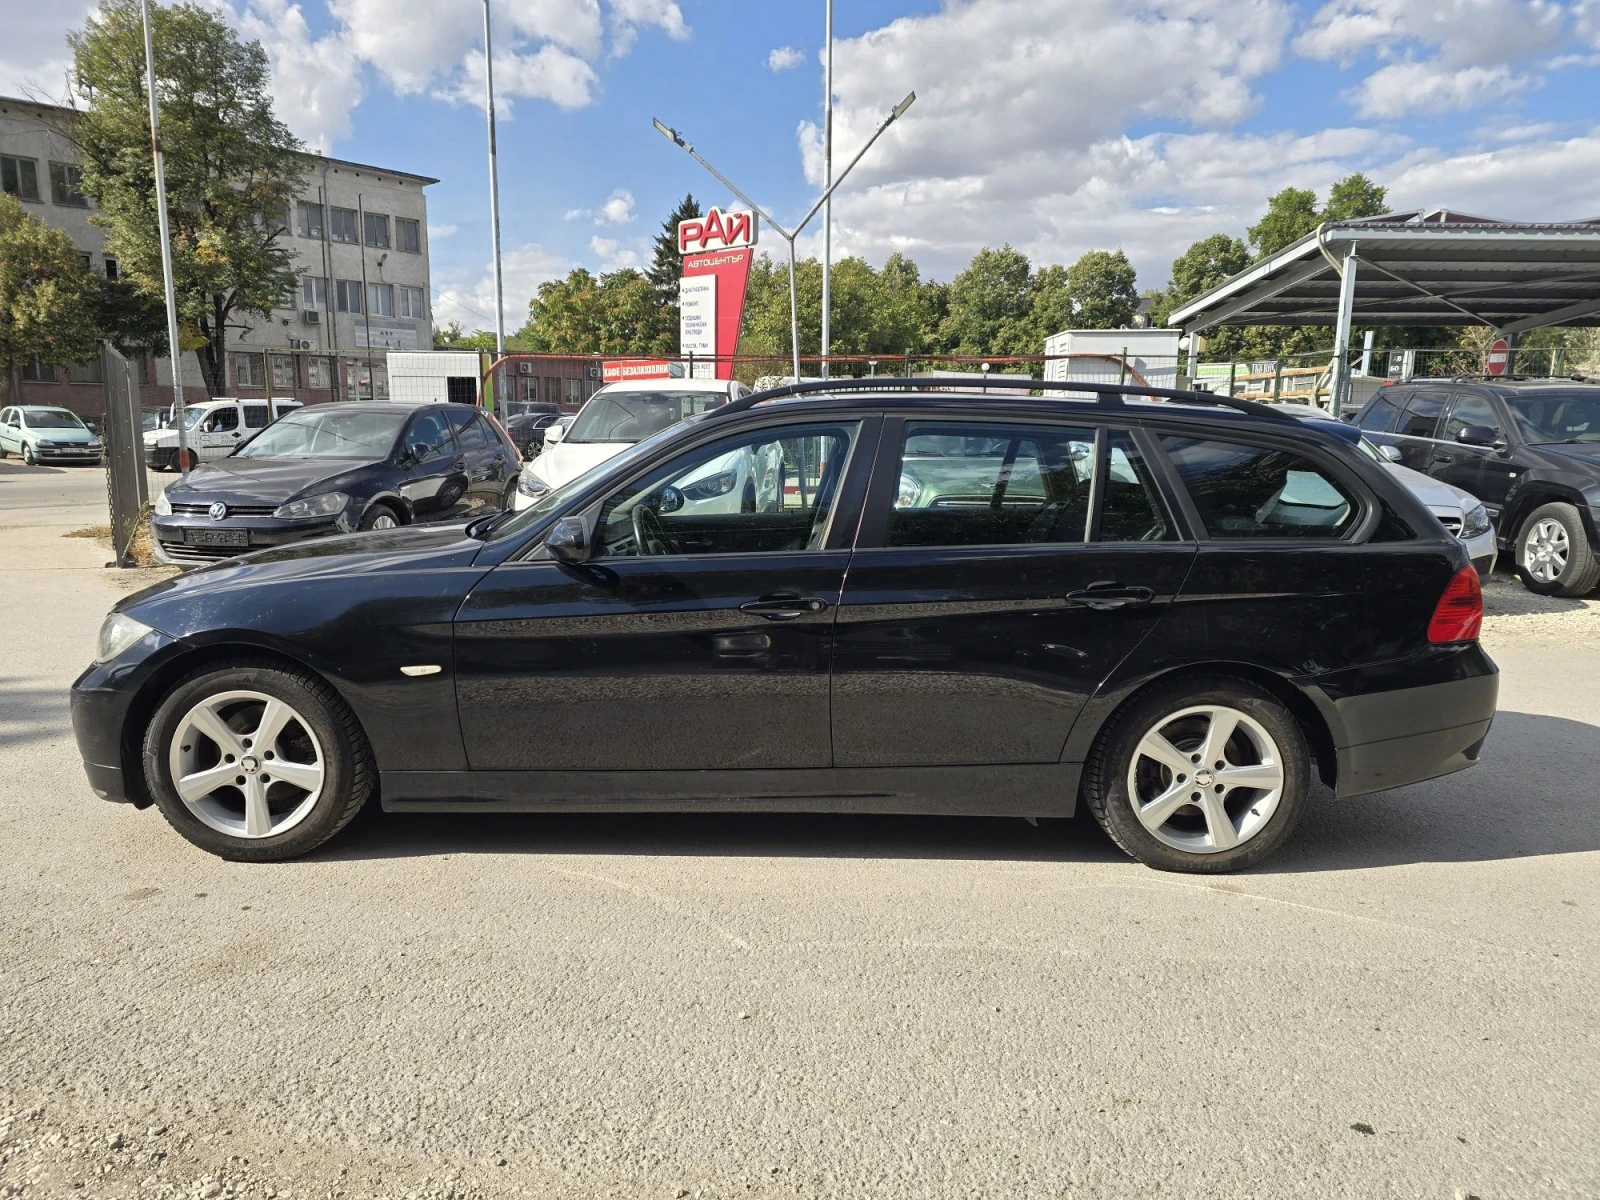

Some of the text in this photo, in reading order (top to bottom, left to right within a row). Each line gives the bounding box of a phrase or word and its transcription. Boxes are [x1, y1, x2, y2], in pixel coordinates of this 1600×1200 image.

[680, 209, 750, 251] РАЙ
[687, 254, 744, 269] АВТОЦЕНТЪР
[604, 364, 669, 377] КАФЕ БЕЗАЛКОХОЛНИ
